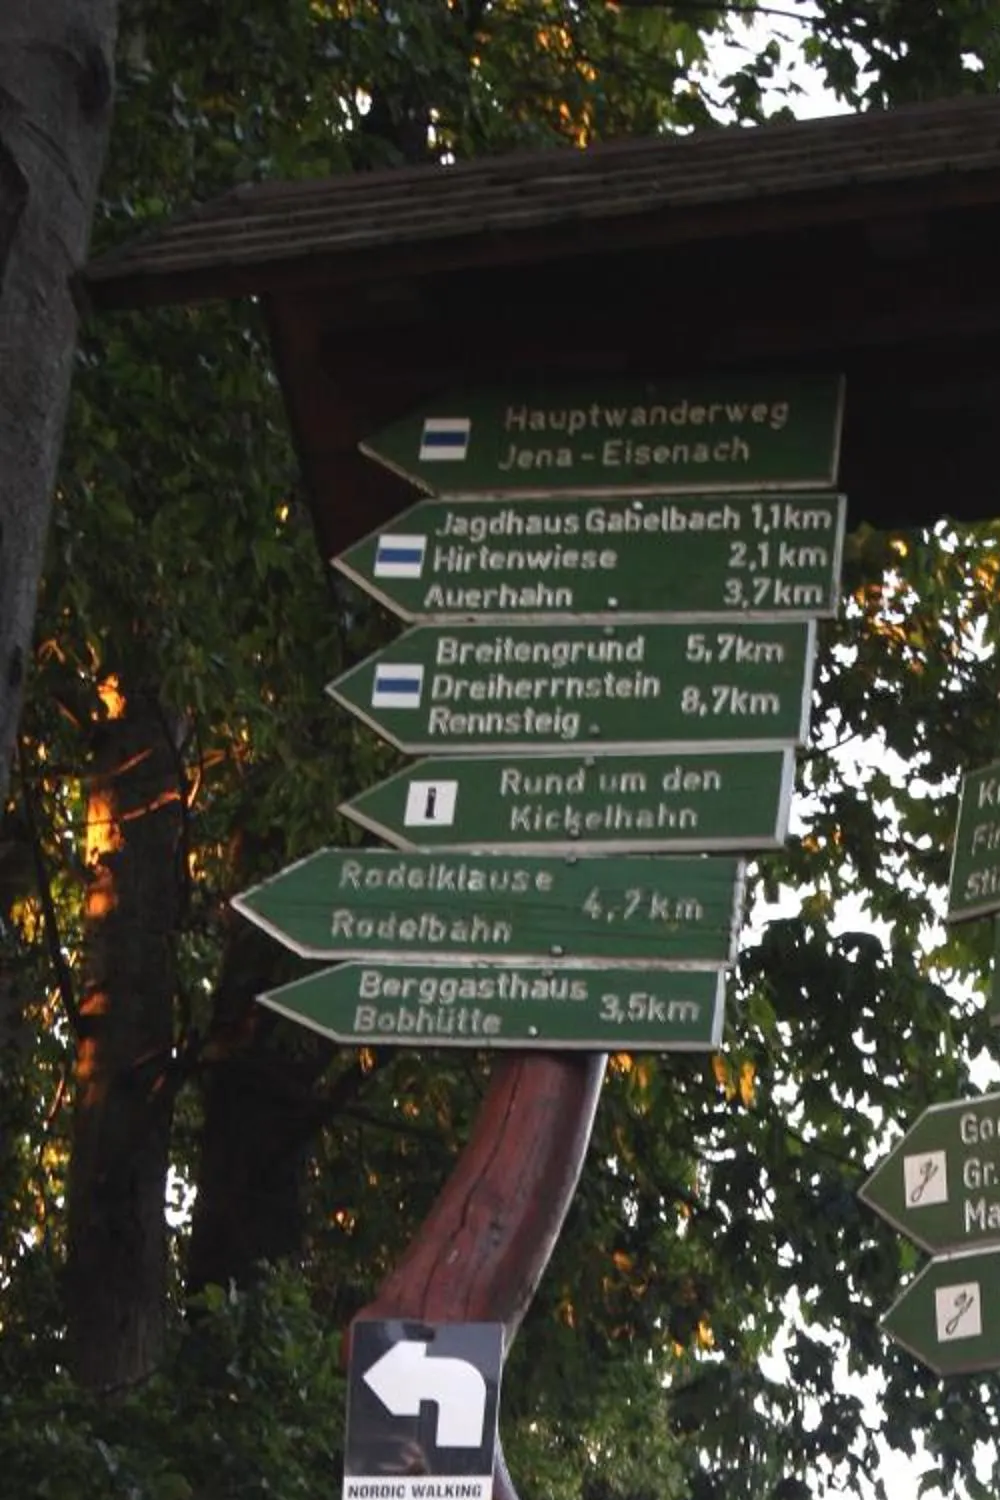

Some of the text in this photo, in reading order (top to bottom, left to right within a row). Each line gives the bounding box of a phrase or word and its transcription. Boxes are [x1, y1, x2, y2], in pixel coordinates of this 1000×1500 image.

[505, 400, 789, 434] Hauptwanderweg
[499, 446, 573, 471] Jena
[602, 439, 750, 466] Eisenach
[436, 511, 578, 542] Jagdhaus
[585, 505, 740, 533] Gabelbach
[433, 546, 618, 573] Hirtenwiese
[424, 582, 573, 608] Auerhahn
[436, 635, 645, 669] Breitengrund
[431, 672, 661, 702] Dreiherrnstein
[427, 709, 581, 739] Rennsteig
[500, 765, 722, 797] Rund um den
[510, 803, 698, 833] Kickelhahn
[338, 858, 554, 892] Rodelklause
[330, 908, 512, 944] Rodelbahn
[358, 971, 588, 1003] Berggasthaus
[353, 1005, 502, 1036] Bobhütte
[347, 1484, 483, 1500] NORDIC WALKING
